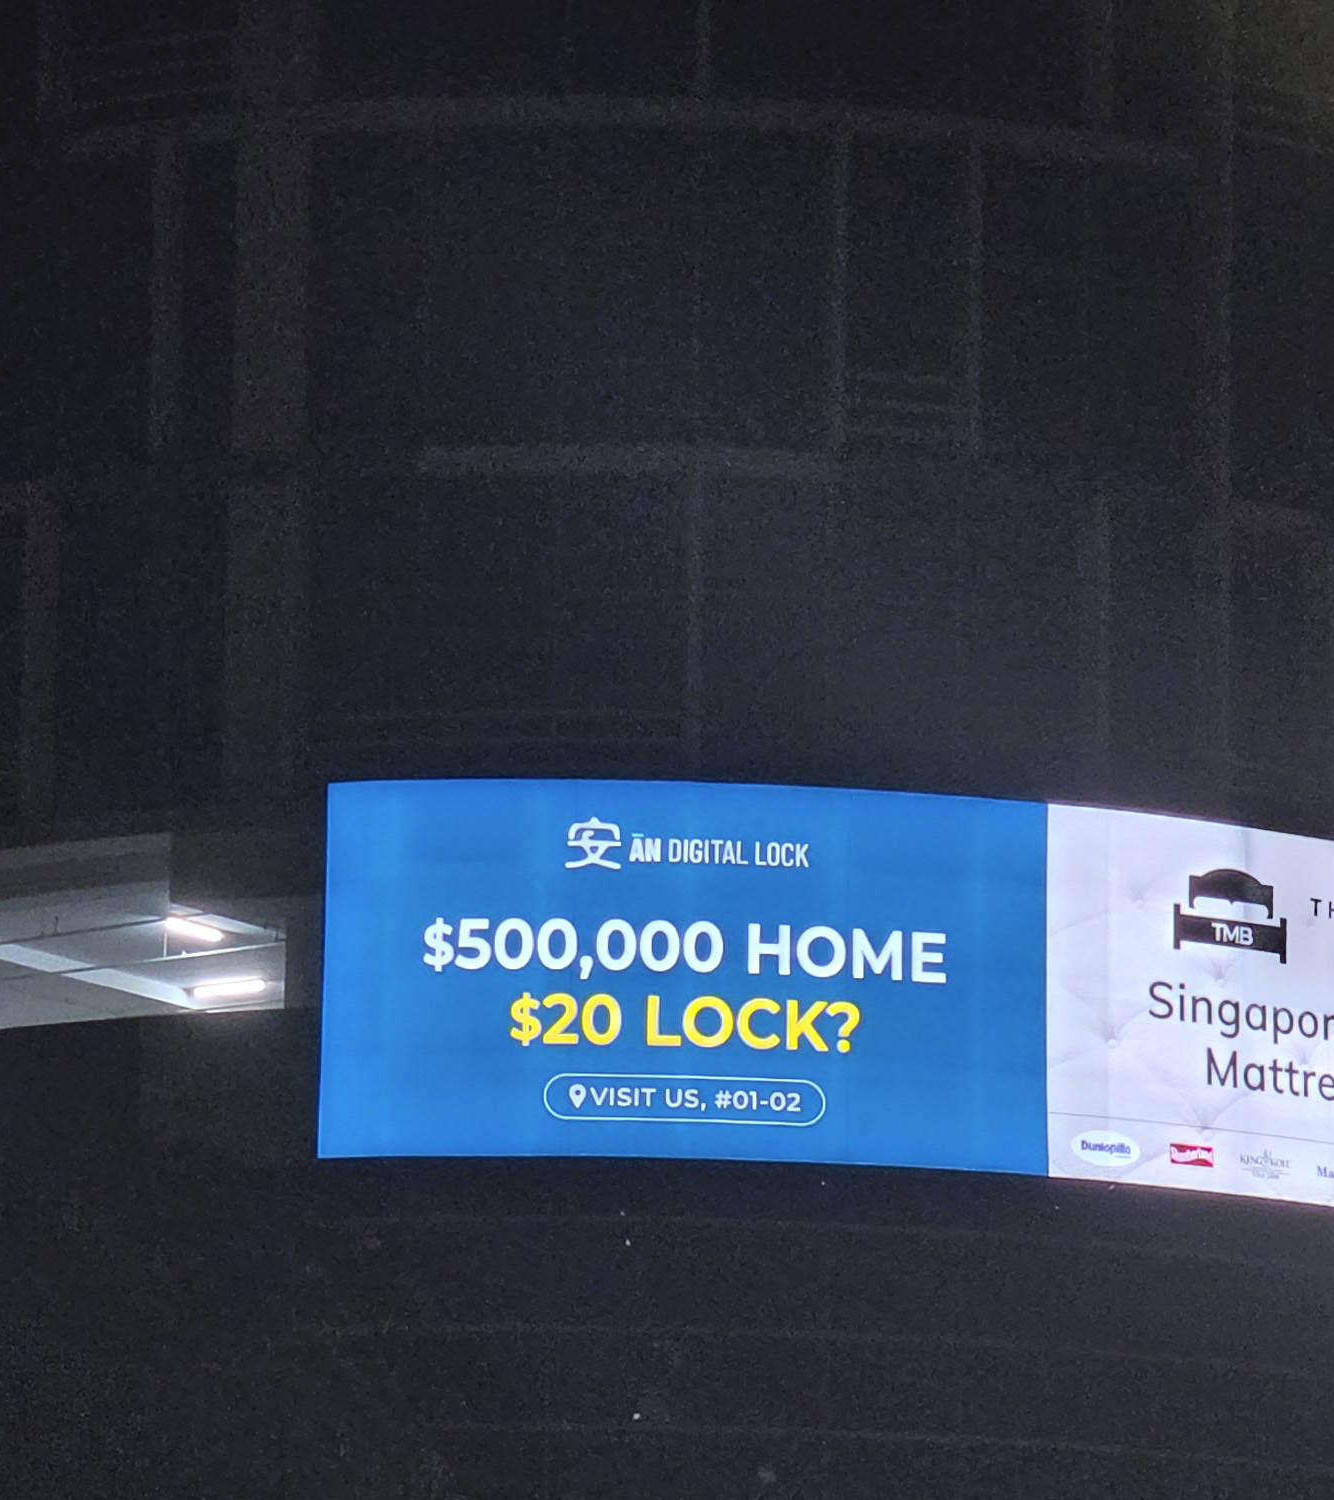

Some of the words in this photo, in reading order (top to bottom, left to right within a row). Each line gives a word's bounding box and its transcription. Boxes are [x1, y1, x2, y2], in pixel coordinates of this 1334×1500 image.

[668, 838, 749, 866] DIGITAL
[755, 841, 810, 868] LOCK
[1211, 921, 1255, 947] TMB
[422, 917, 724, 980] $500,000
[747, 922, 947, 984] HOME
[509, 992, 622, 1047] $20
[646, 995, 861, 1053] LOCK?
[590, 1086, 657, 1111] VISIT
[664, 1088, 707, 1113] US,
[715, 1090, 802, 1114] #01-02
